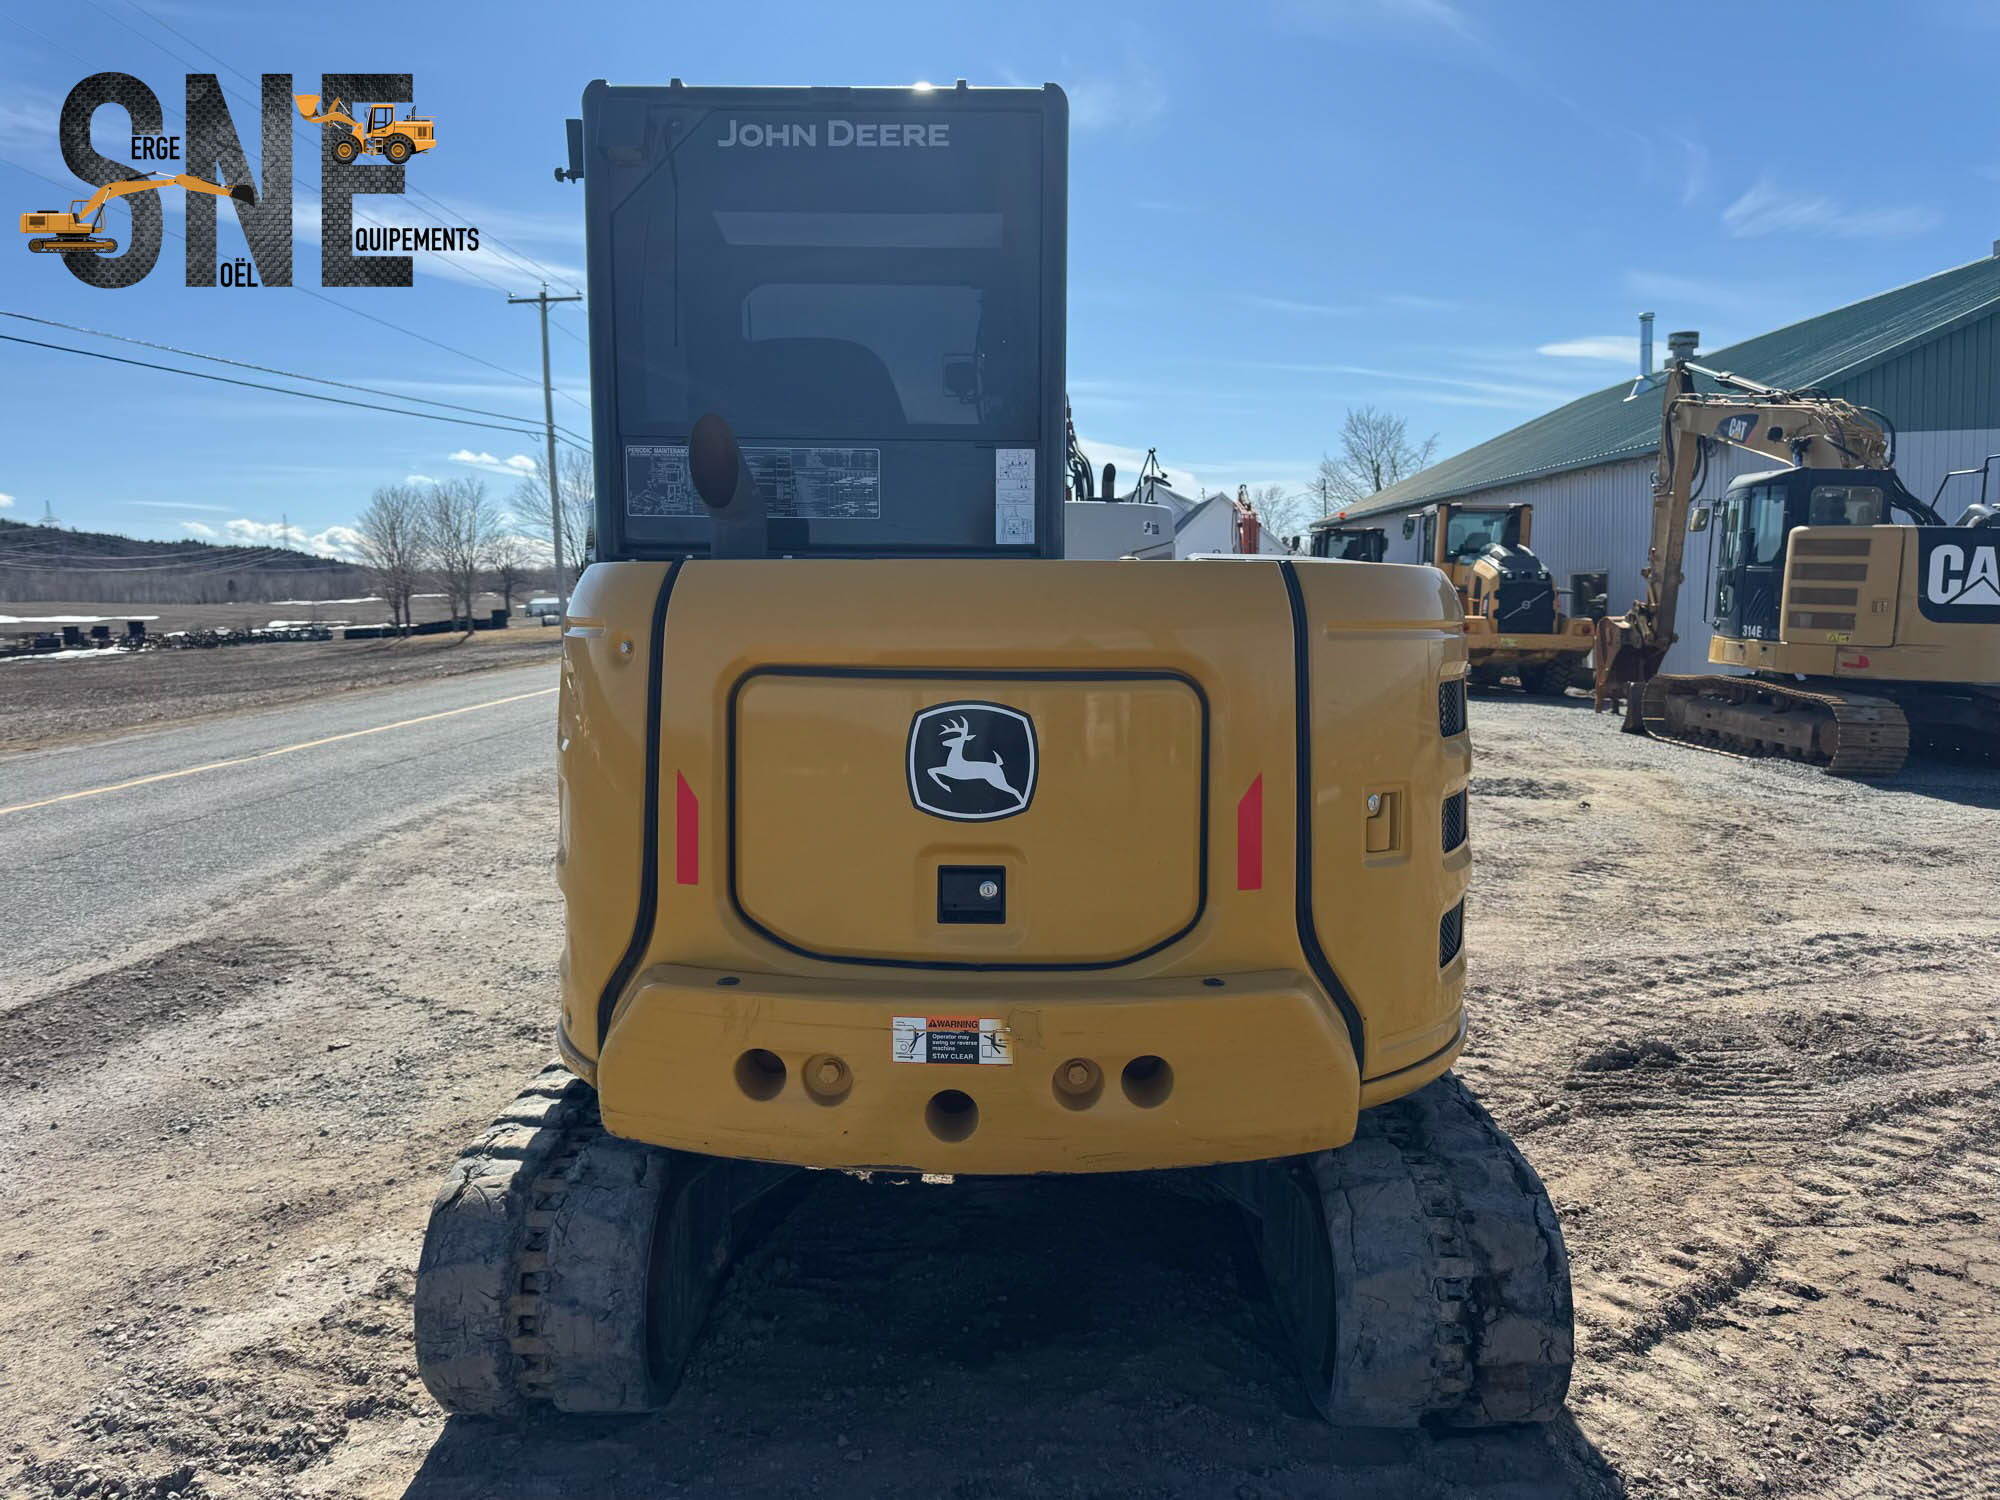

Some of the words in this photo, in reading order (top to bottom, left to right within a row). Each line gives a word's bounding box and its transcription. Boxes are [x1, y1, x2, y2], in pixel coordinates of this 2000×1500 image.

[717, 119, 817, 147] JOHN
[827, 119, 950, 147] DEERE
[1728, 417, 1747, 441] CAT
[1927, 544, 2000, 605] CA
[1742, 624, 1763, 638] 314E
[937, 1020, 978, 1028] WARNING
